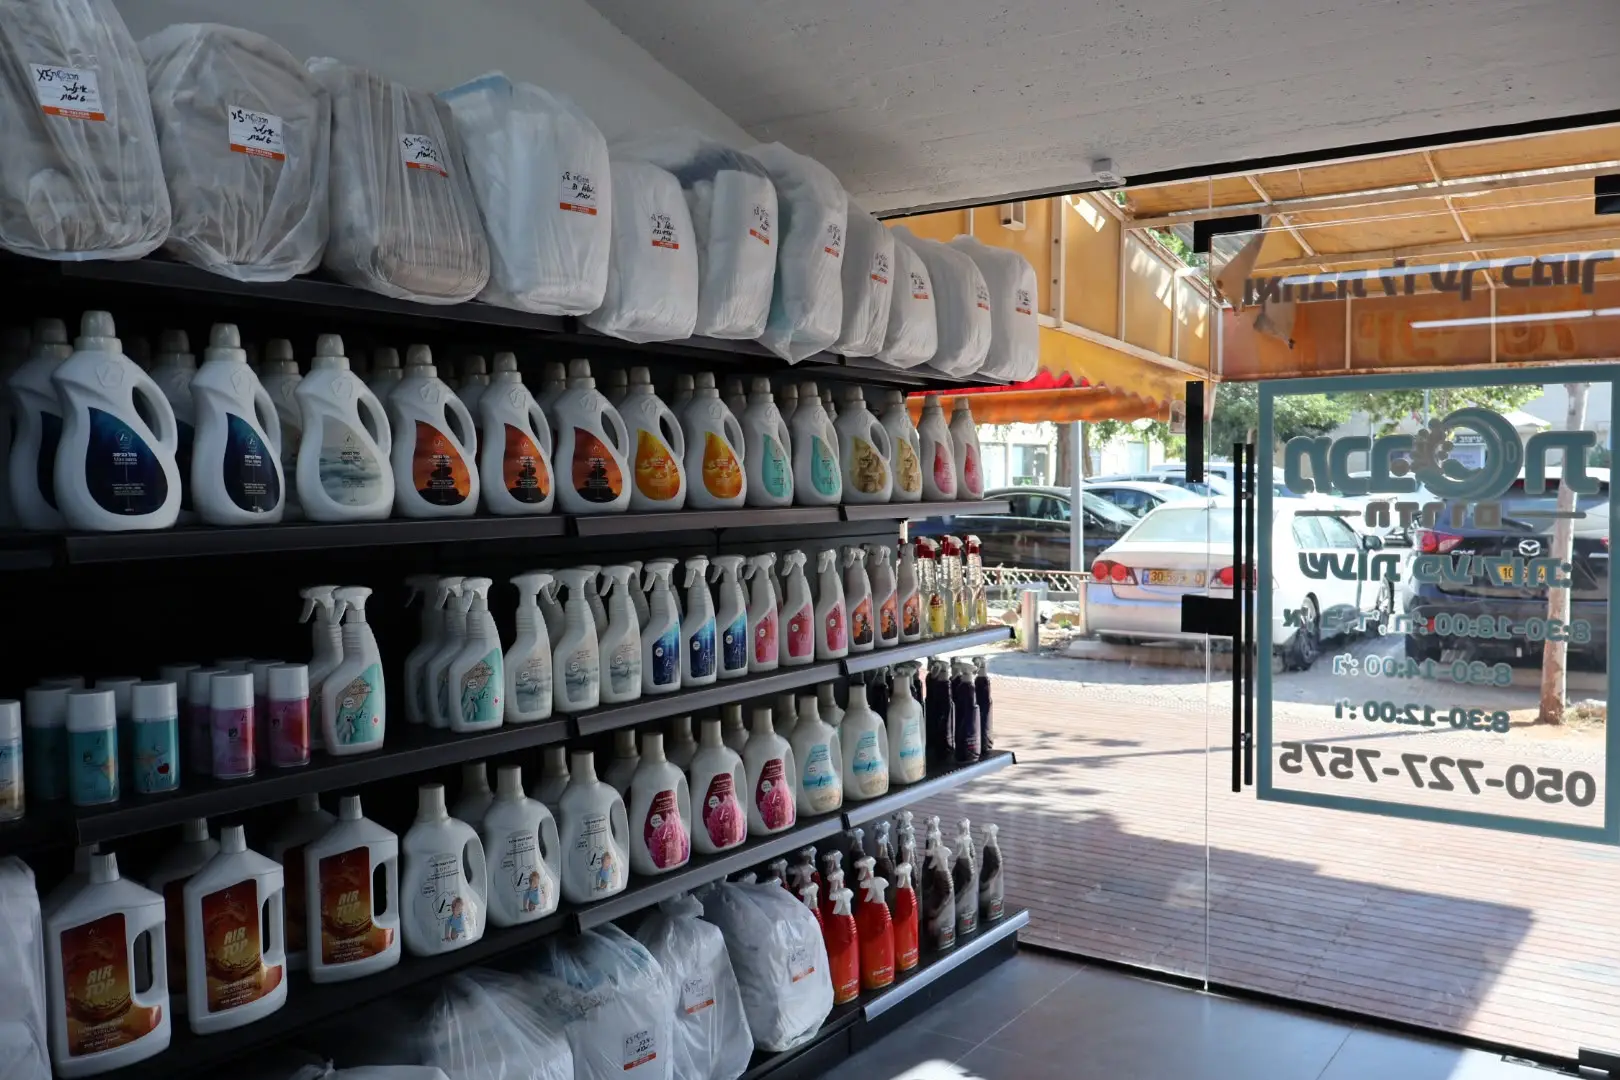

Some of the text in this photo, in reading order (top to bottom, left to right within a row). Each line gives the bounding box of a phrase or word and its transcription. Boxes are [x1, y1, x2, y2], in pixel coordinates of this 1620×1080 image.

[339, 889, 360, 906] AIR
[337, 900, 361, 919] TOP
[224, 926, 247, 945] AIR
[223, 938, 248, 958] TOP
[86, 964, 115, 986] AIR
[86, 978, 116, 999] TOP
